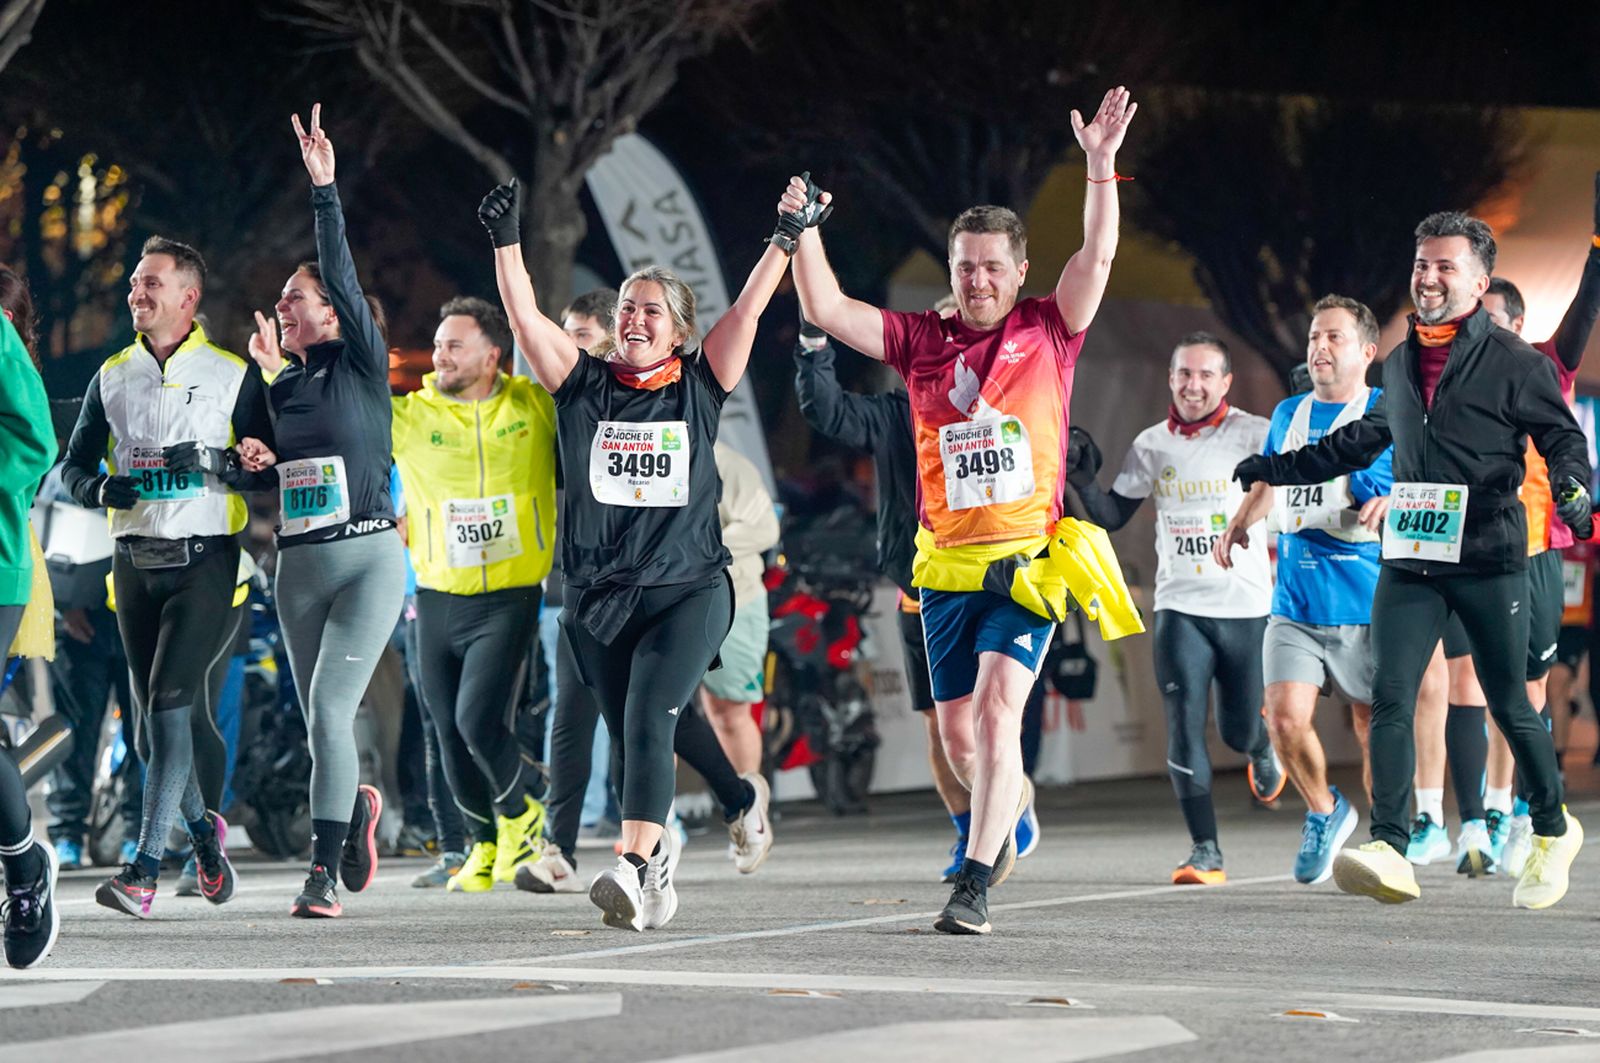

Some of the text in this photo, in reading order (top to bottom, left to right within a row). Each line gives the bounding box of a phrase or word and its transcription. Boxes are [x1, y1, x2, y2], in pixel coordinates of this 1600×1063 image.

[601, 441, 621, 450] SAN
[613, 432, 641, 441] NOCHE
[643, 432, 654, 441] DE
[954, 431, 981, 442] NOCHE
[982, 428, 993, 437] DE
[948, 442, 963, 455] SAN
[608, 452, 671, 478] 3499
[955, 447, 1015, 479] 3498
[142, 469, 189, 492] 8176
[1153, 479, 1228, 504] Arjona
[291, 486, 328, 510] 8176
[345, 519, 391, 536] NIKE
[457, 519, 504, 544] 3502
[1397, 511, 1449, 534] 8402
